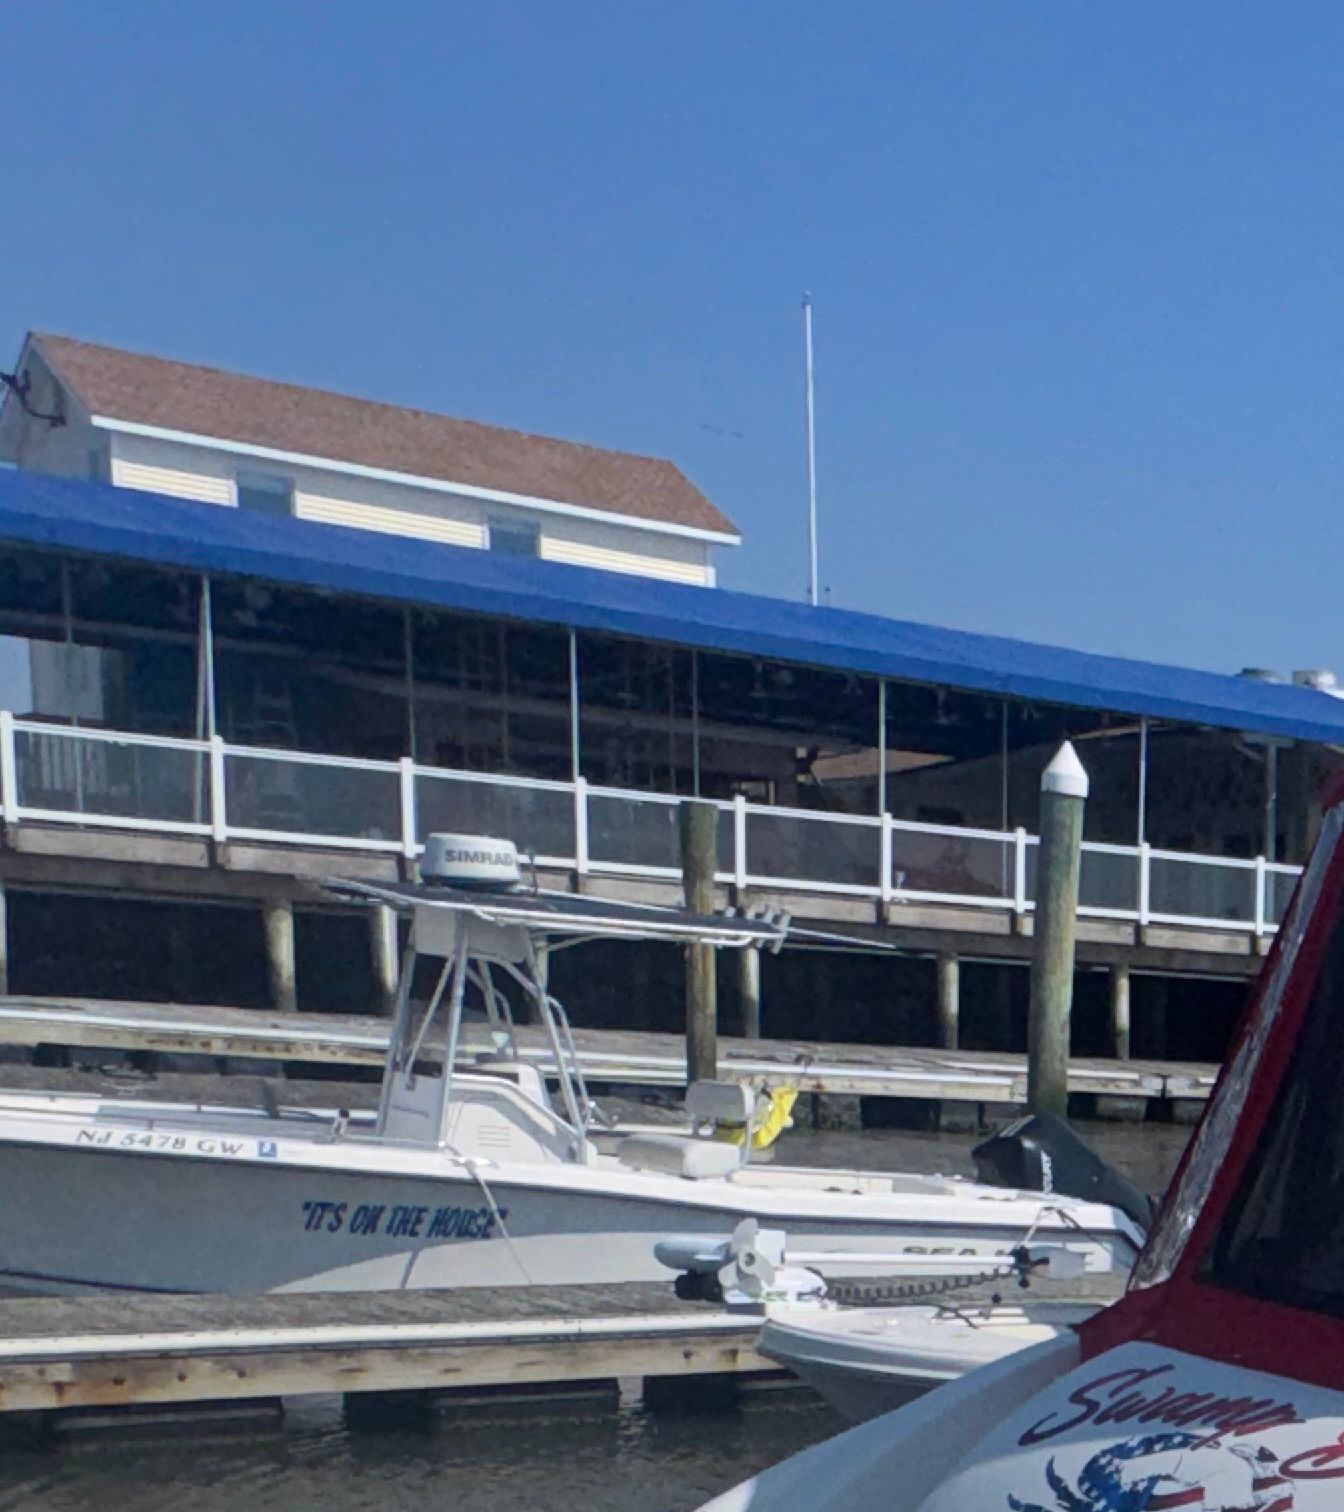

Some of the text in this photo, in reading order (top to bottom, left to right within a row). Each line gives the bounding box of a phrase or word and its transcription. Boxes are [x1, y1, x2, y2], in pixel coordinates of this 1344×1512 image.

[76, 1129, 244, 1155] NJ 5478 GW
[350, 1204, 386, 1235] ON
[385, 1206, 429, 1238] THE
[1018, 1364, 1305, 1451] Swamp
